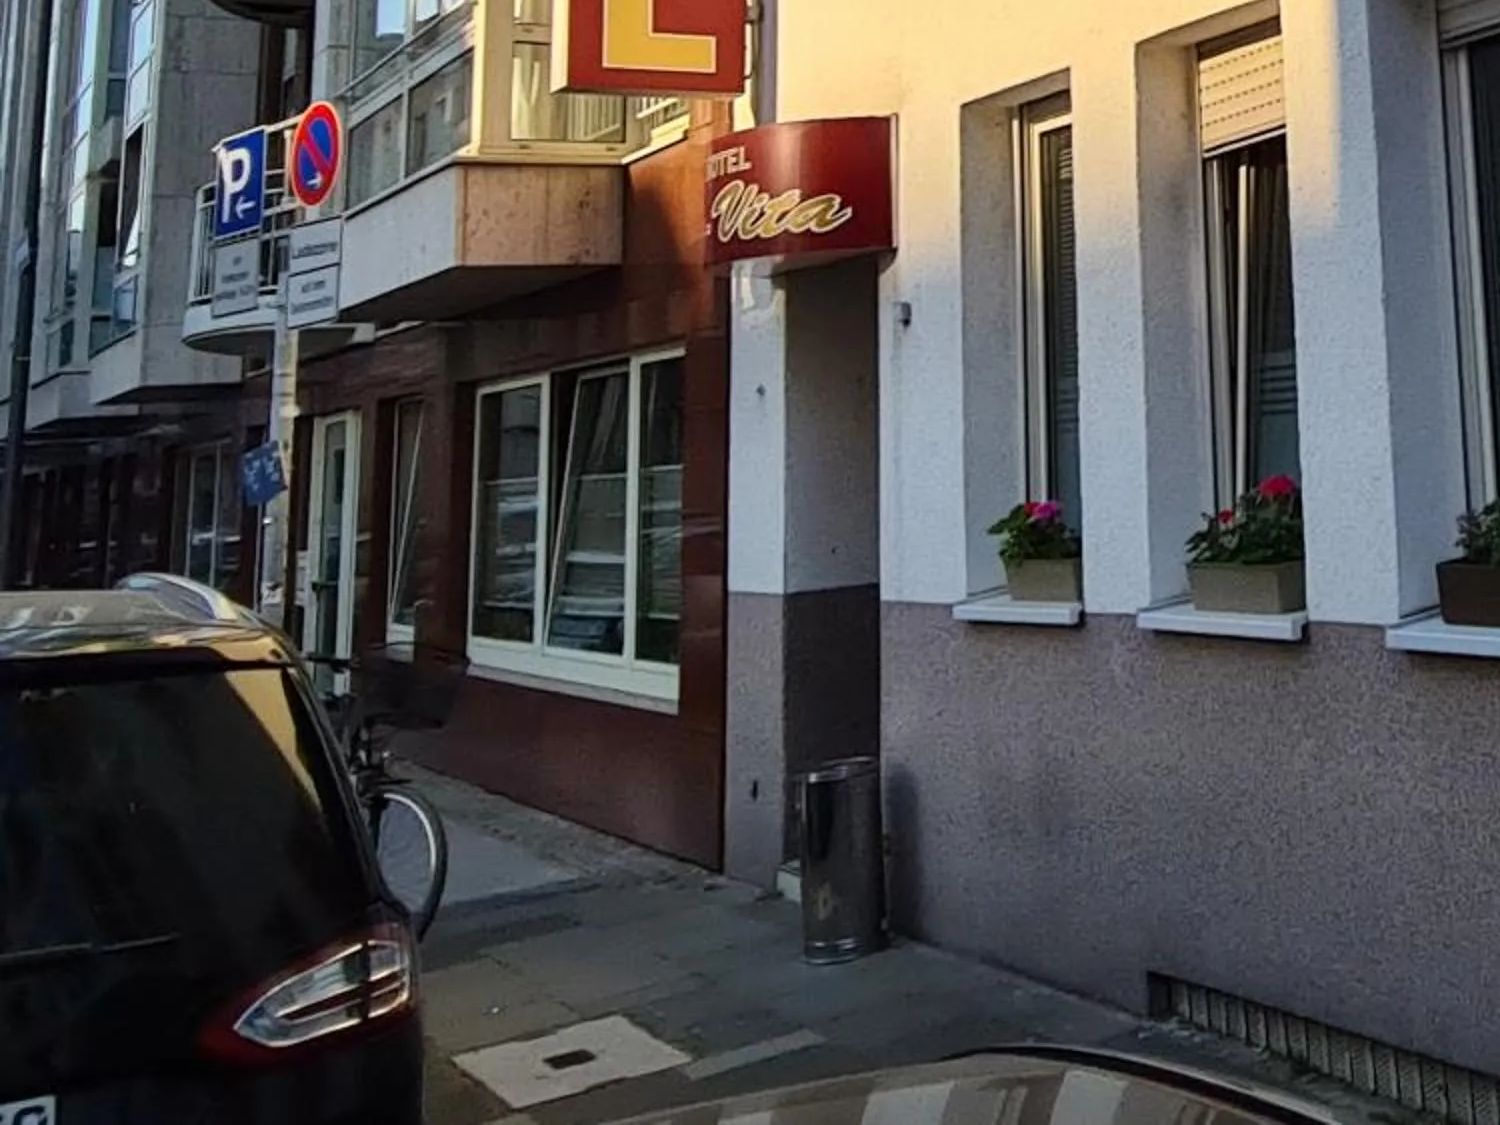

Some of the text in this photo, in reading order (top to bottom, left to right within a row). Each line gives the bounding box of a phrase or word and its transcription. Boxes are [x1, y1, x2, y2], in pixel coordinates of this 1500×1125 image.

[217, 146, 250, 224] P
[706, 145, 753, 181] OTEL
[711, 179, 853, 244] Vita
